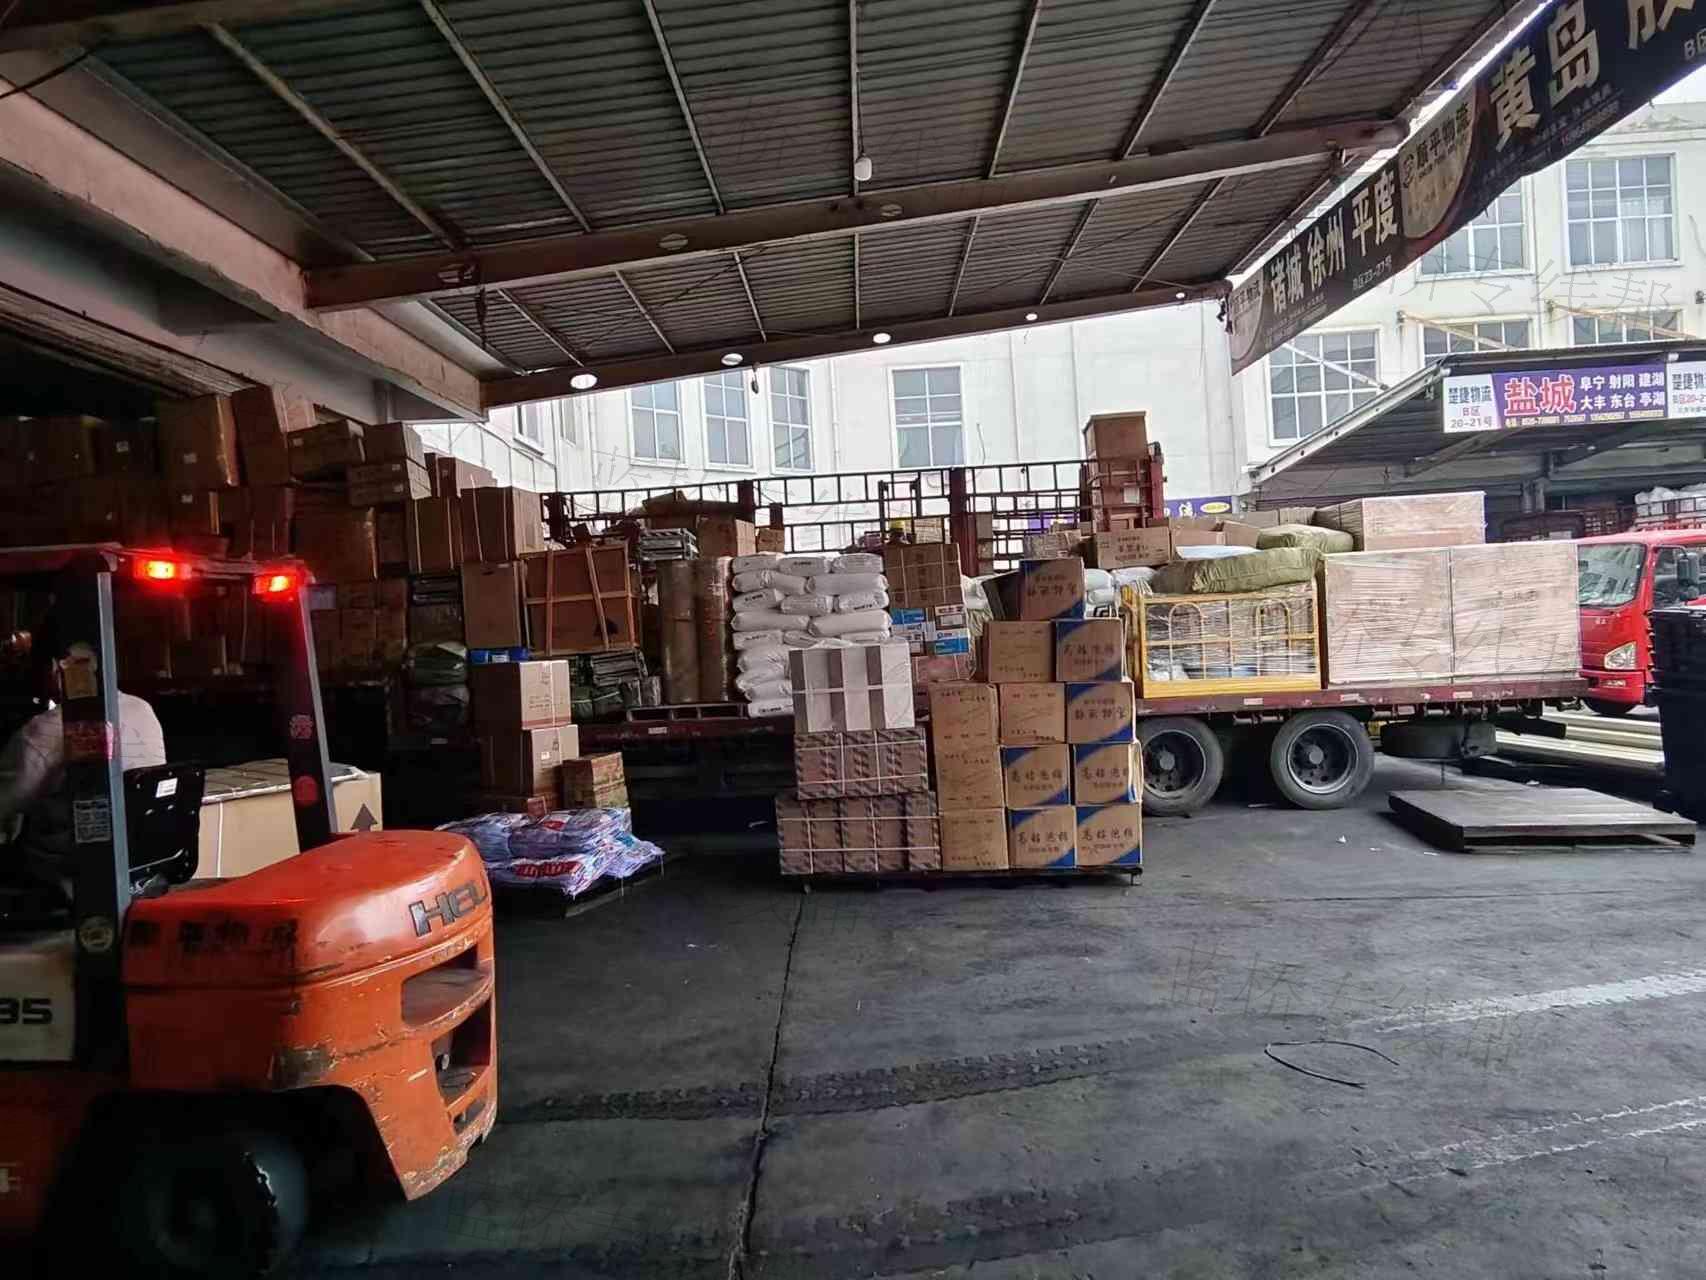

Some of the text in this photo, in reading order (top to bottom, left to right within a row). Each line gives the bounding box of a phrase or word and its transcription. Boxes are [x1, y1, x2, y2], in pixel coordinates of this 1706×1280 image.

[1490, 1, 1600, 152] 黄岛
[1271, 243, 1304, 313] 诸城
[1307, 207, 1346, 291] 徐州
[1351, 169, 1398, 257] 平度
[1504, 373, 1576, 416] 盐城
[1581, 371, 1665, 391] 阜宁 射阳 建湖
[1581, 391, 1665, 410] 大丰 东台 亭湖
